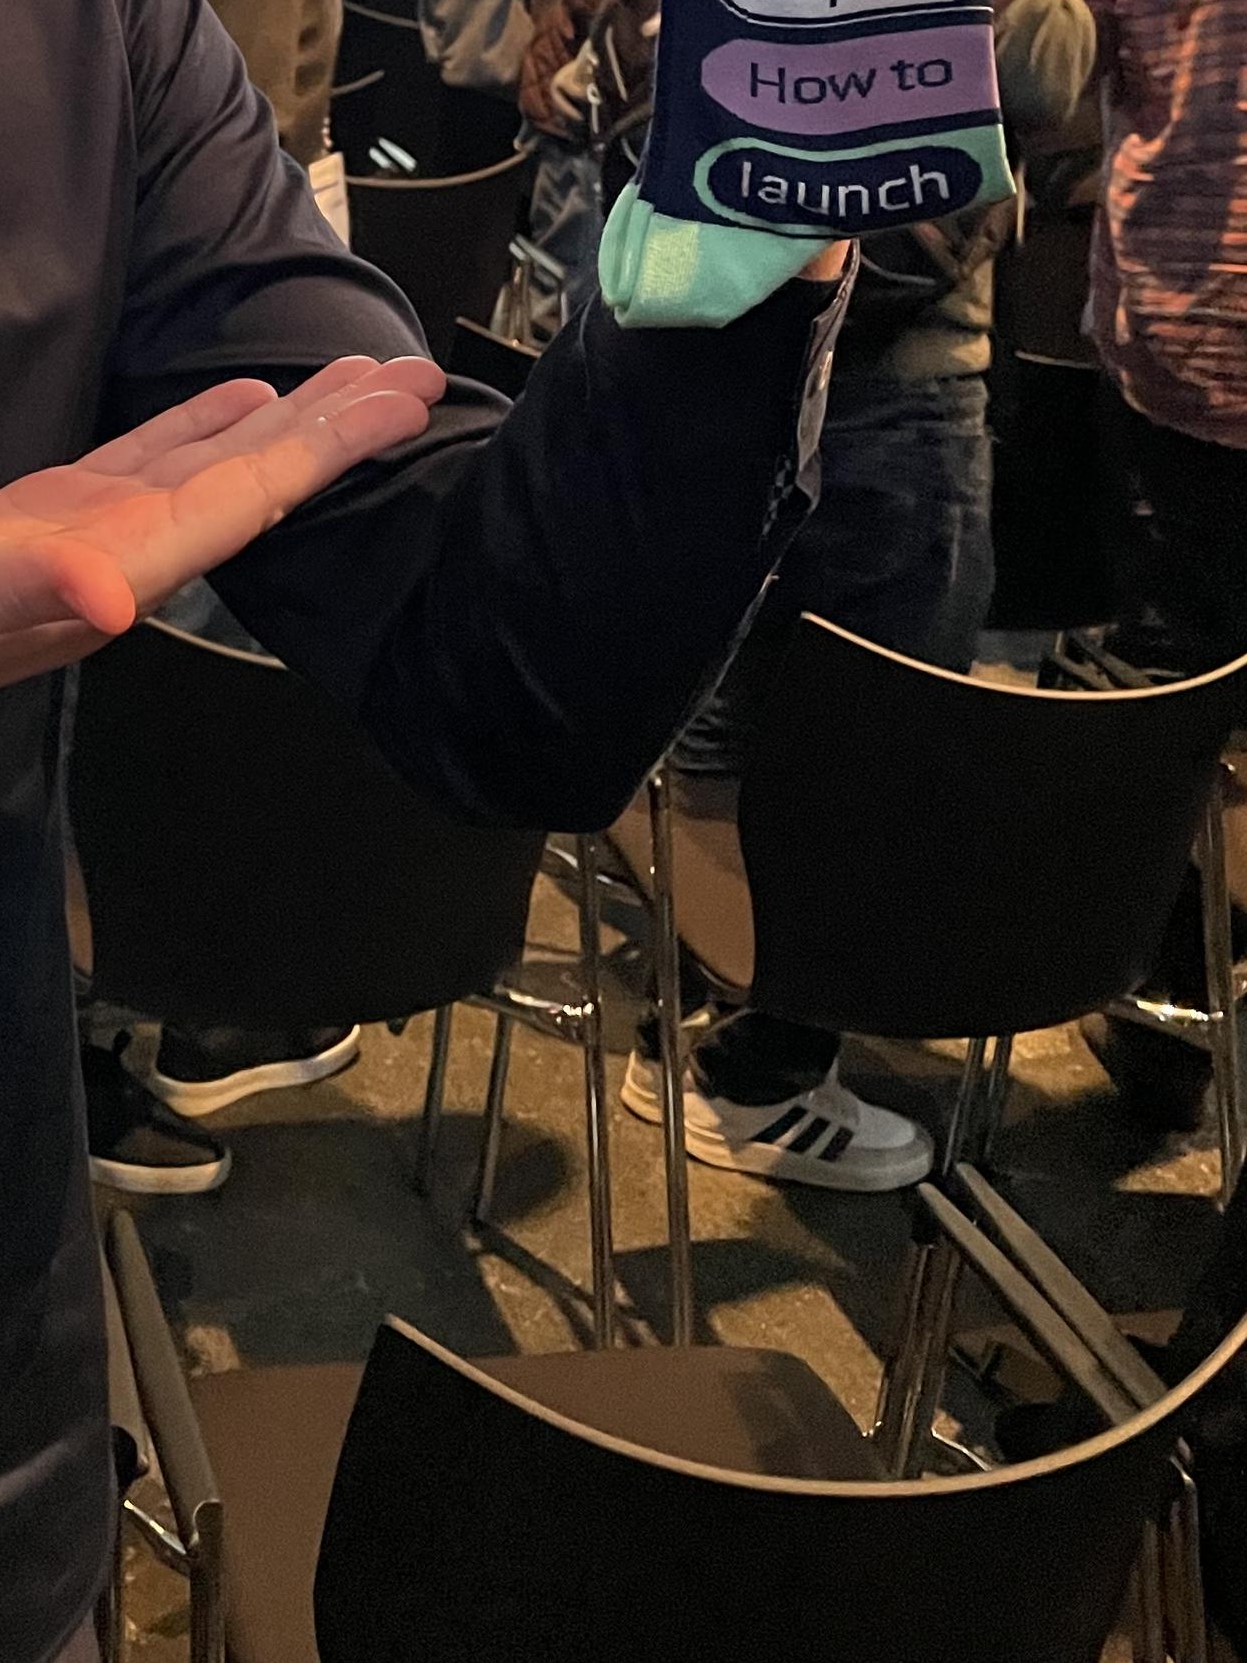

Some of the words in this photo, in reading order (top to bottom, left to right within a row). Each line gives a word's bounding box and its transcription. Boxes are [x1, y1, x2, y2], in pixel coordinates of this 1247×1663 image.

[749, 61, 877, 106] How
[890, 57, 952, 90] to
[738, 160, 951, 217] launch
